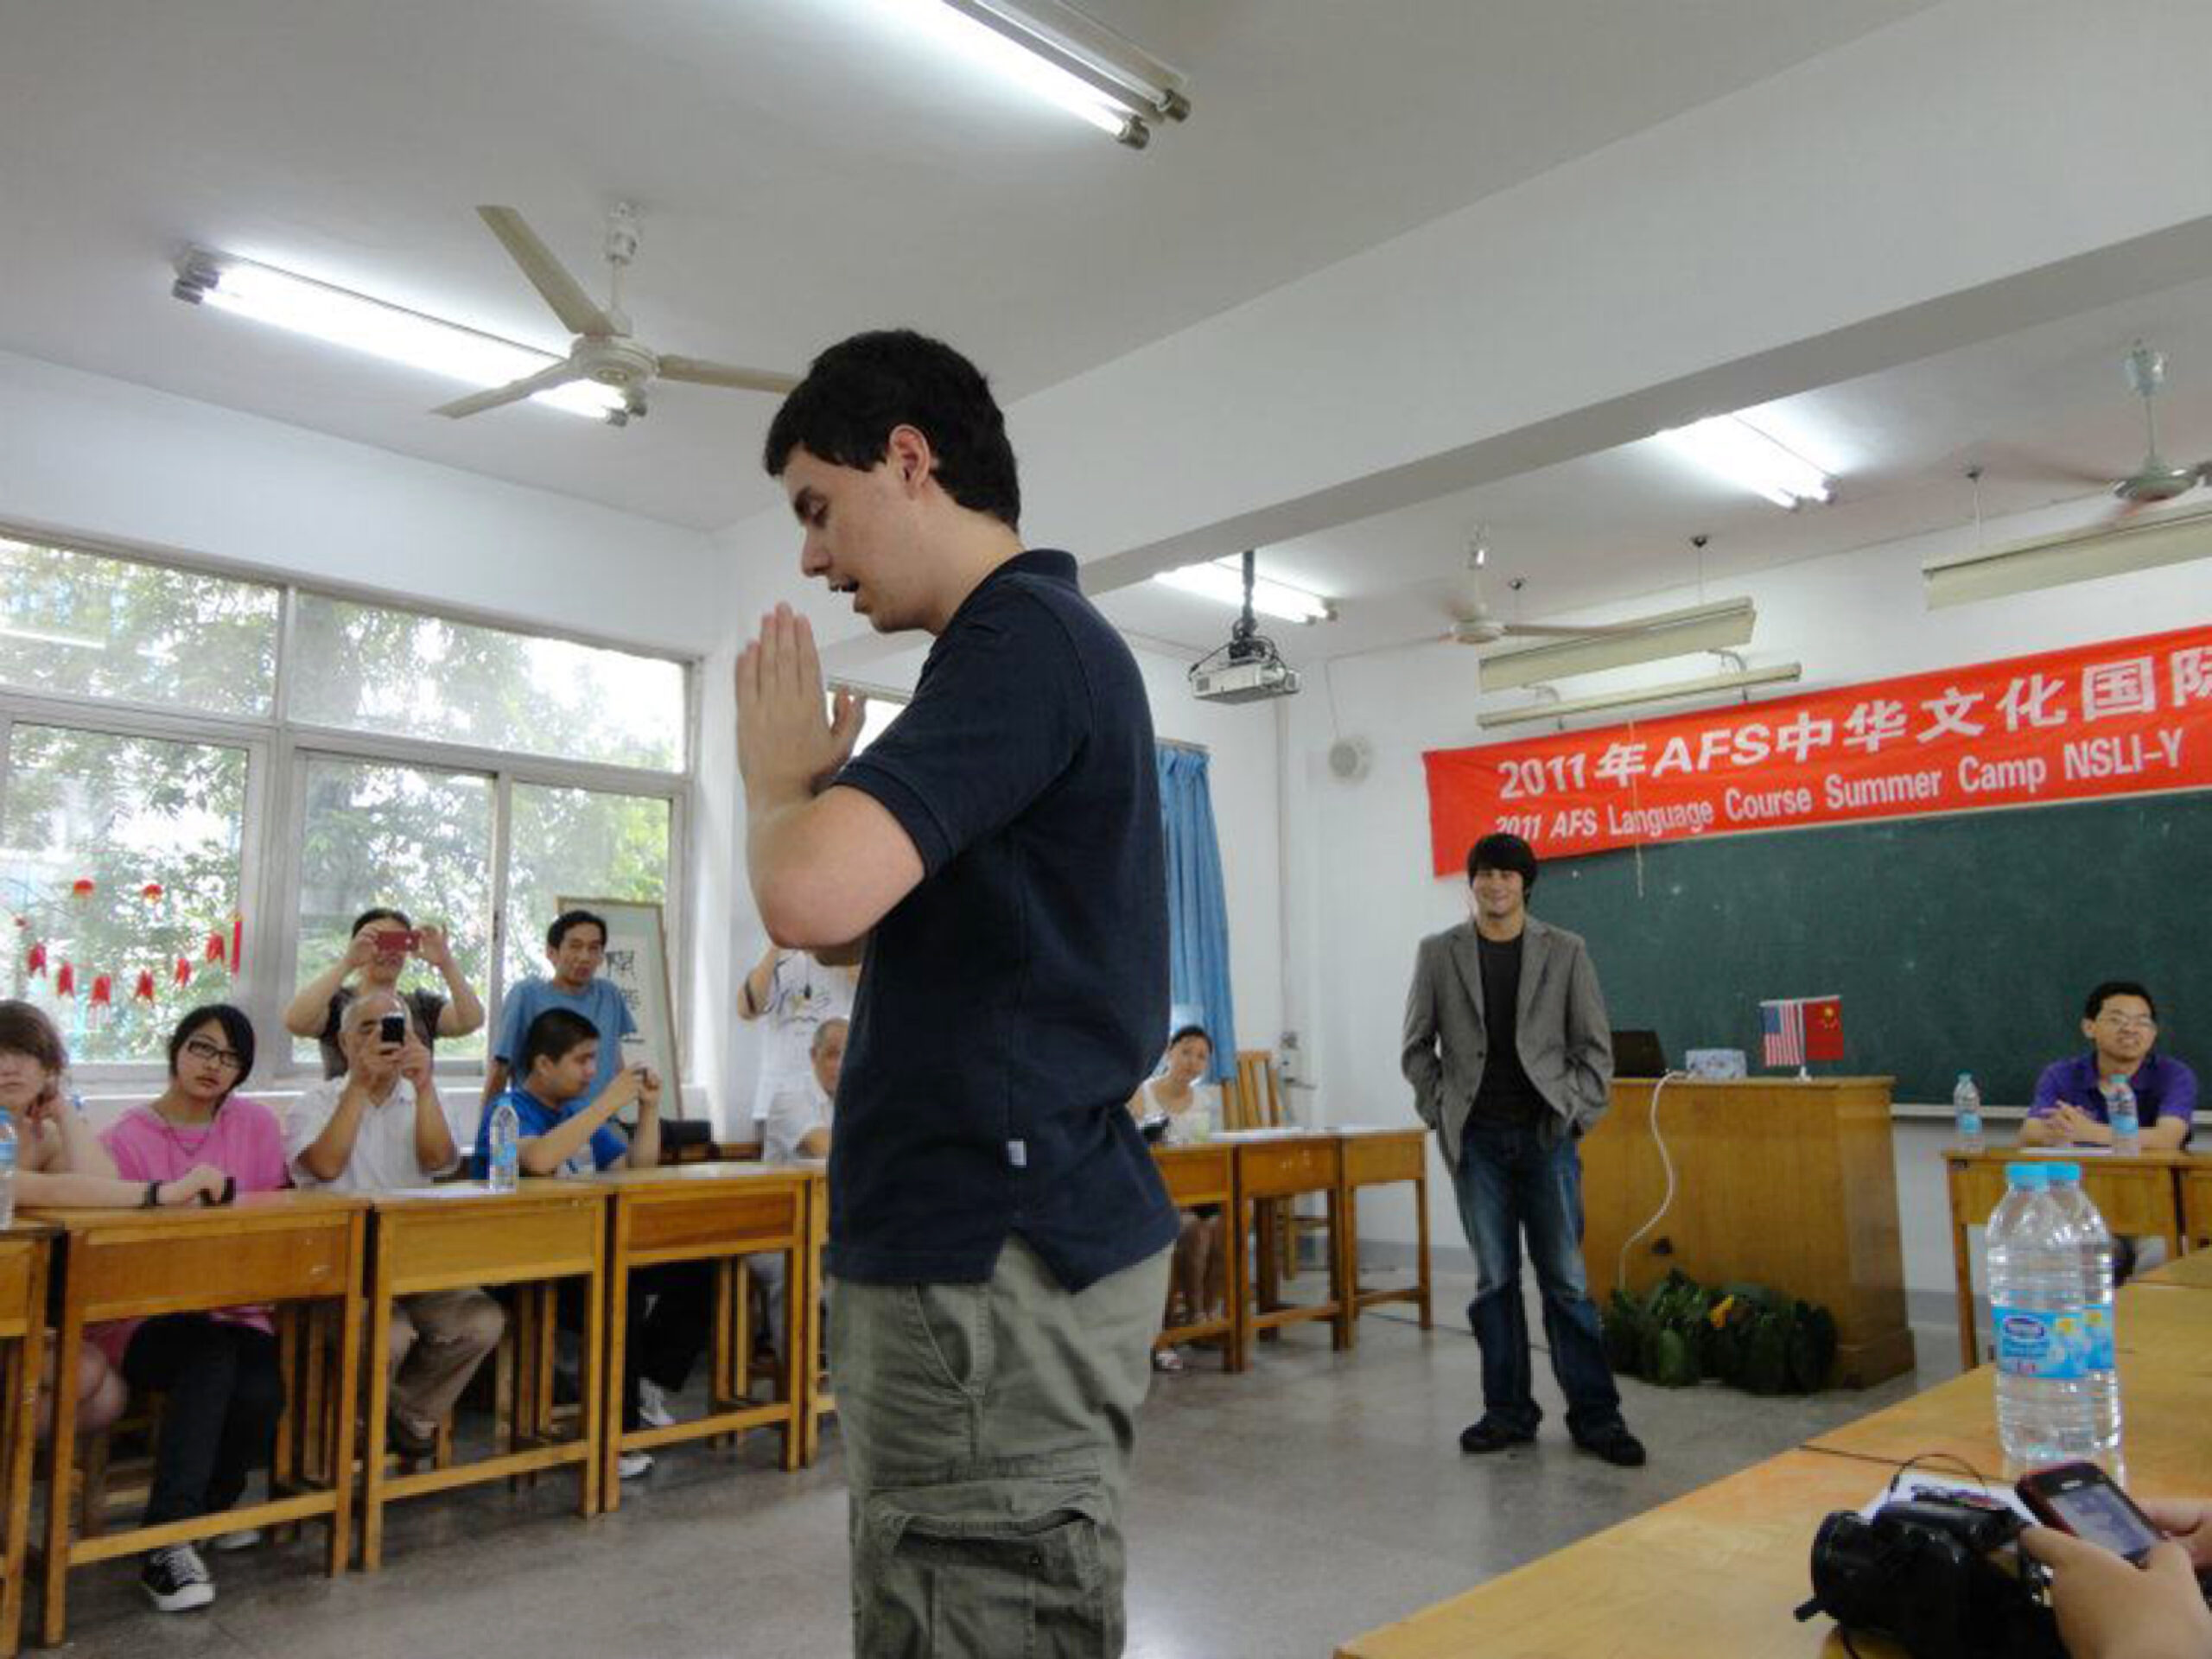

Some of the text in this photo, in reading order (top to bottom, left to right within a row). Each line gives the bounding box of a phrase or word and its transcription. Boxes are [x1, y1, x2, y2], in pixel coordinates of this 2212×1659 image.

[1496, 728, 2183, 842] 2011 AFS Language Course Summer Camp NSLI-Y
